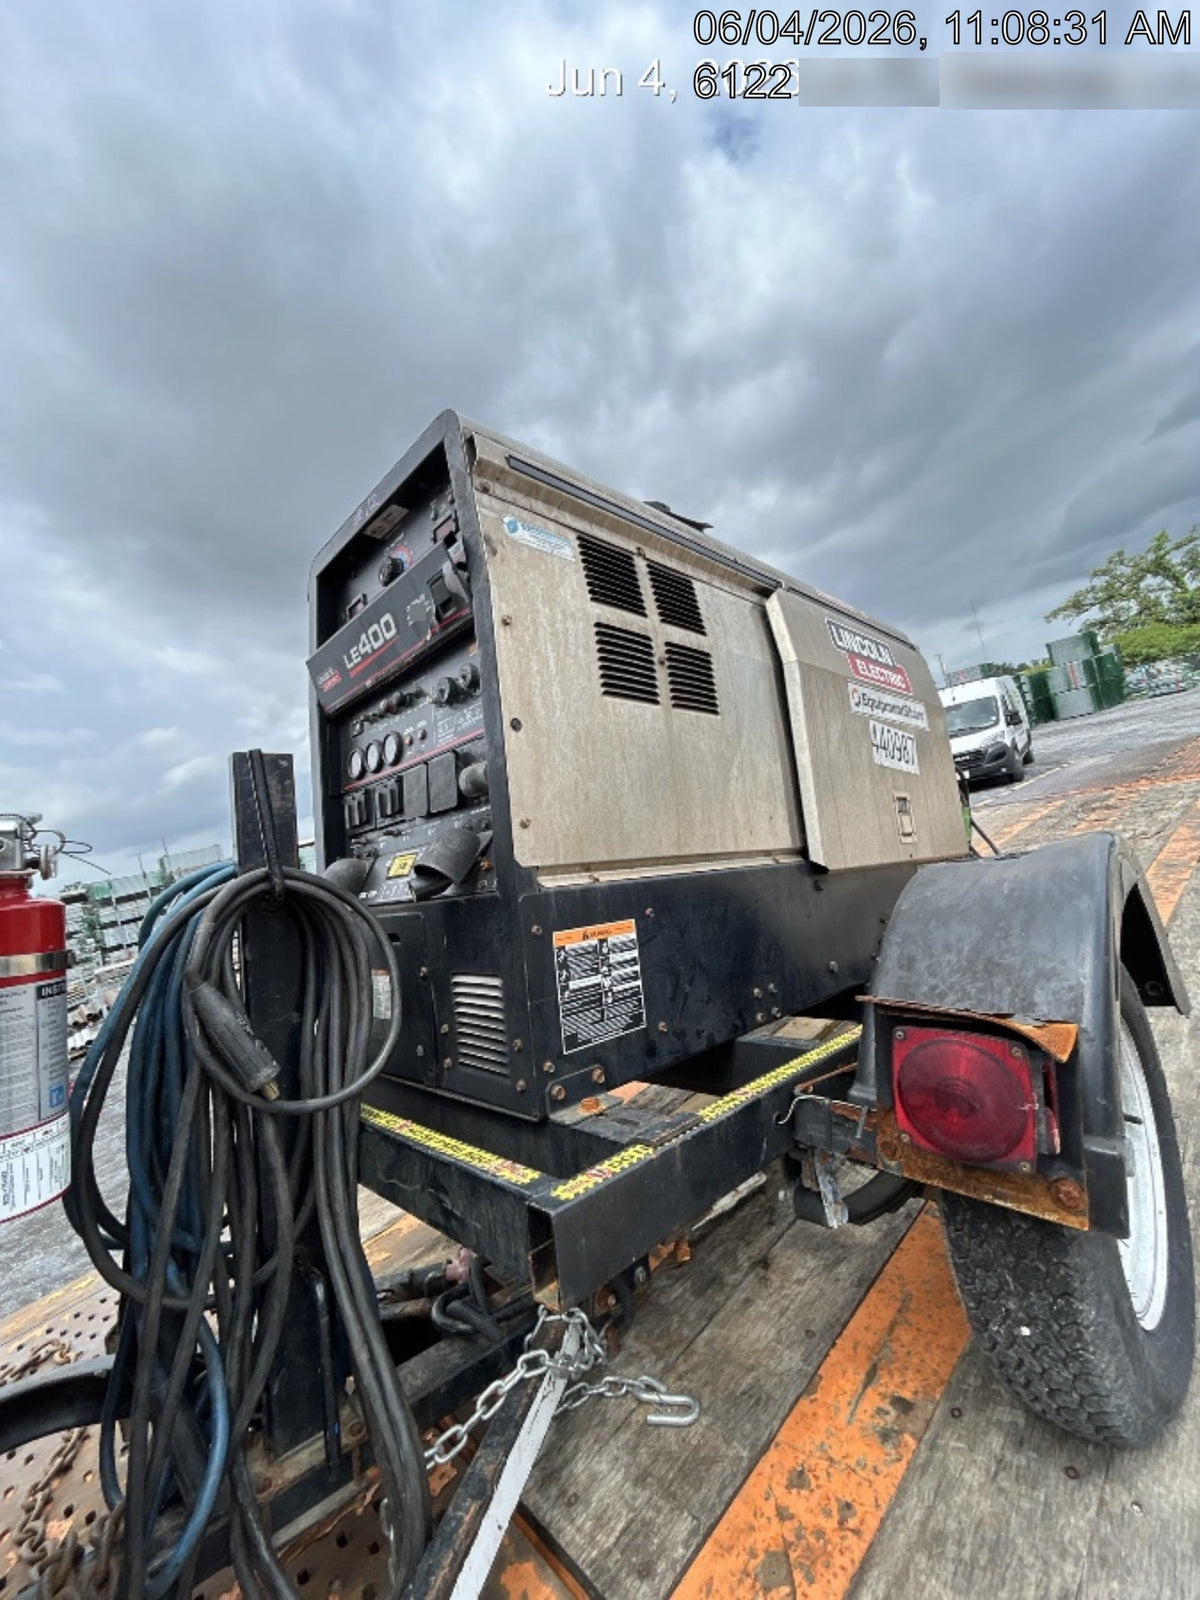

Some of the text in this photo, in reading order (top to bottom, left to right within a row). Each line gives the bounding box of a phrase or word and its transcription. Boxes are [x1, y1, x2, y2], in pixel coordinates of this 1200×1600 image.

[342, 612, 398, 670] LE400
[830, 623, 894, 668] LINCOLN
[855, 658, 907, 689] ELECTRIC
